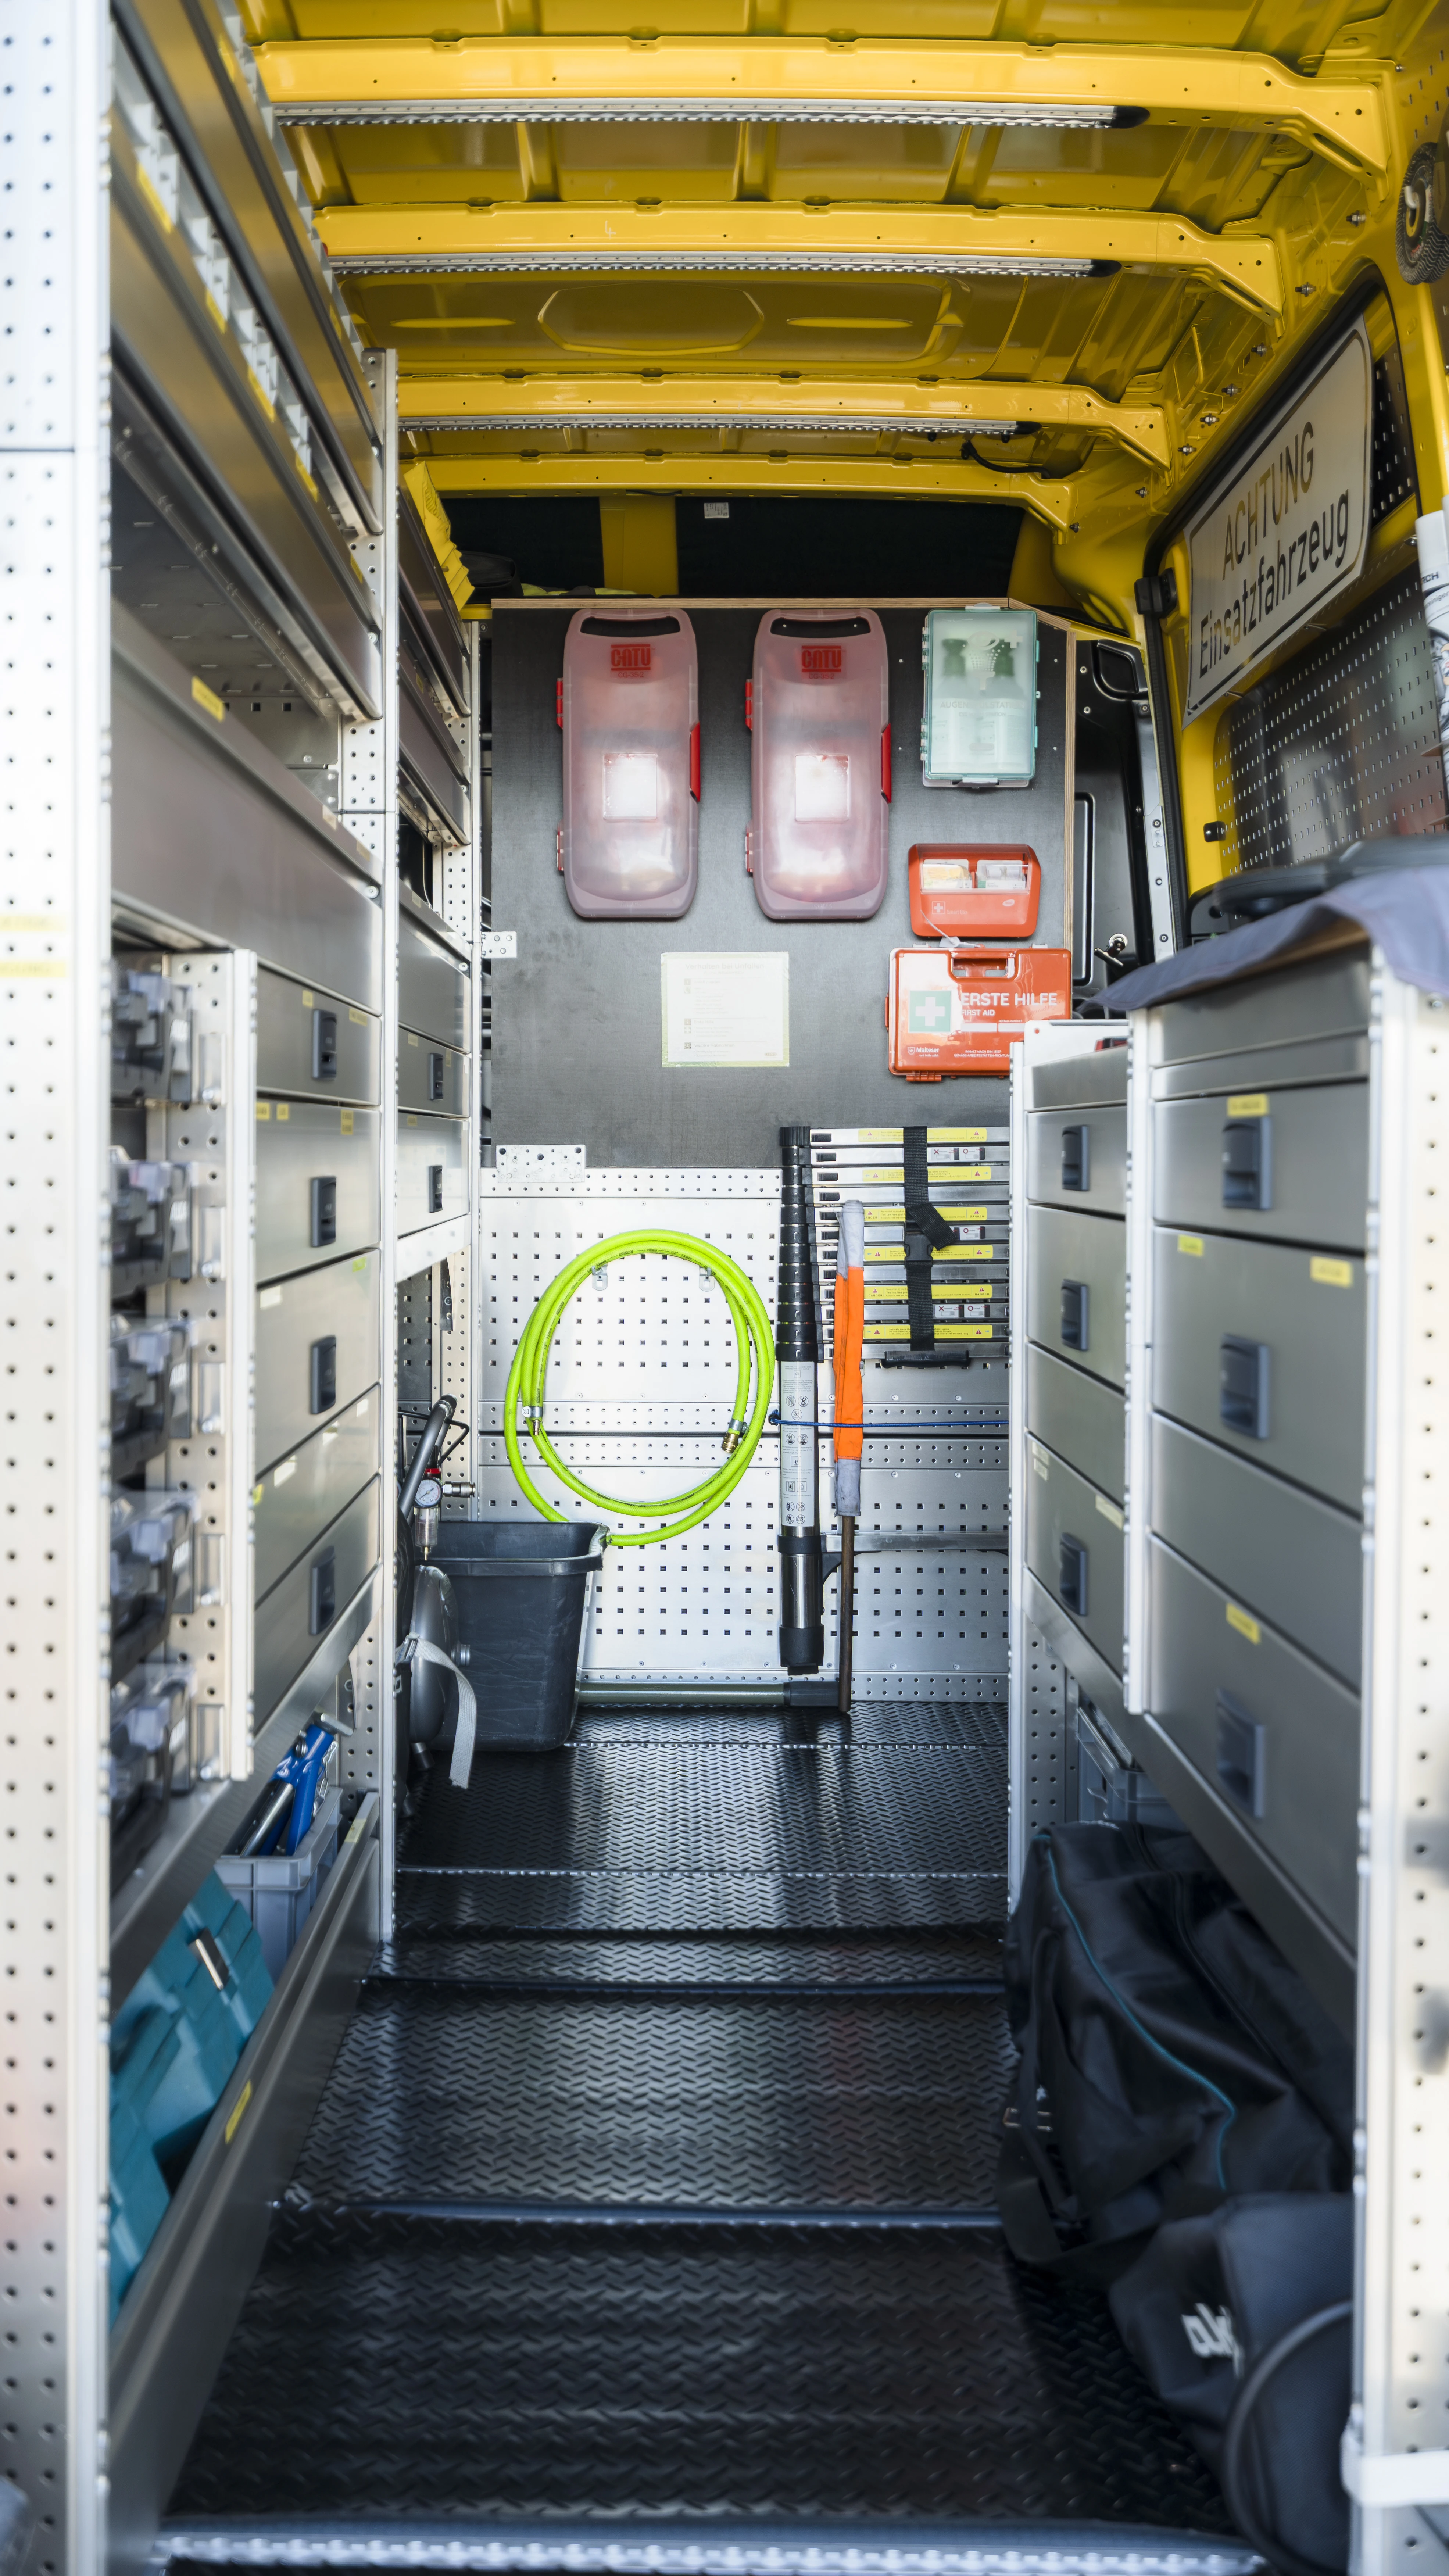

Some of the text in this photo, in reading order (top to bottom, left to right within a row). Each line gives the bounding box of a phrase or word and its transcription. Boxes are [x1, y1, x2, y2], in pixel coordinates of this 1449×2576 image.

[1223, 421, 1314, 581] ACHTUNG
[1199, 489, 1349, 679] Einsatzfahrzeug
[611, 648, 651, 667] CATU
[801, 649, 841, 668] CATU
[961, 992, 1058, 1006] ERSTE HILFE
